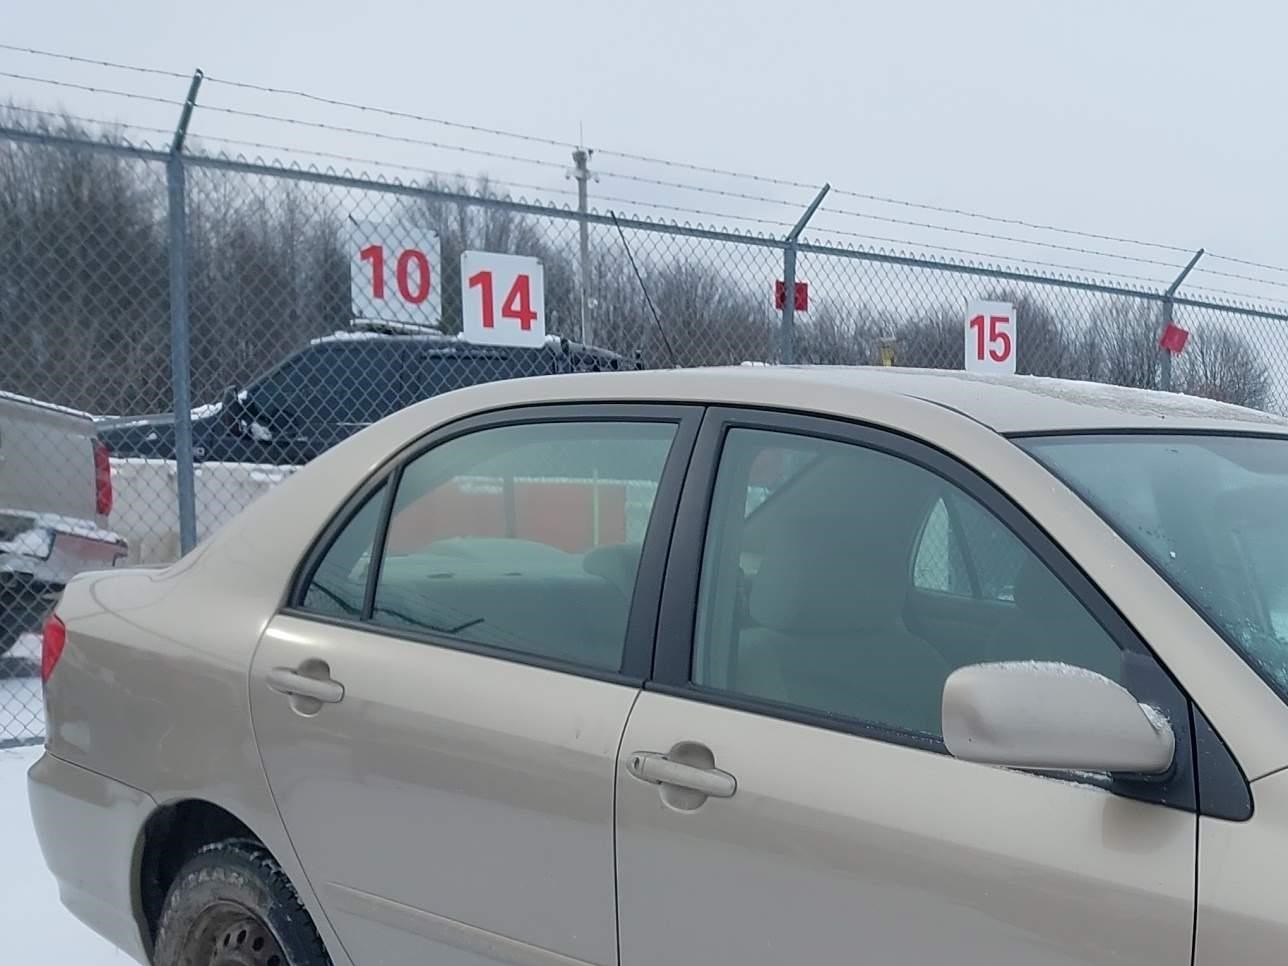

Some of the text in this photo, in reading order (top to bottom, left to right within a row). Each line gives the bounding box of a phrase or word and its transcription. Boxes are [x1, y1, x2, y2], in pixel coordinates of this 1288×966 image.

[360, 244, 431, 305] 10
[469, 270, 537, 331] 14
[969, 314, 1012, 363] 15
